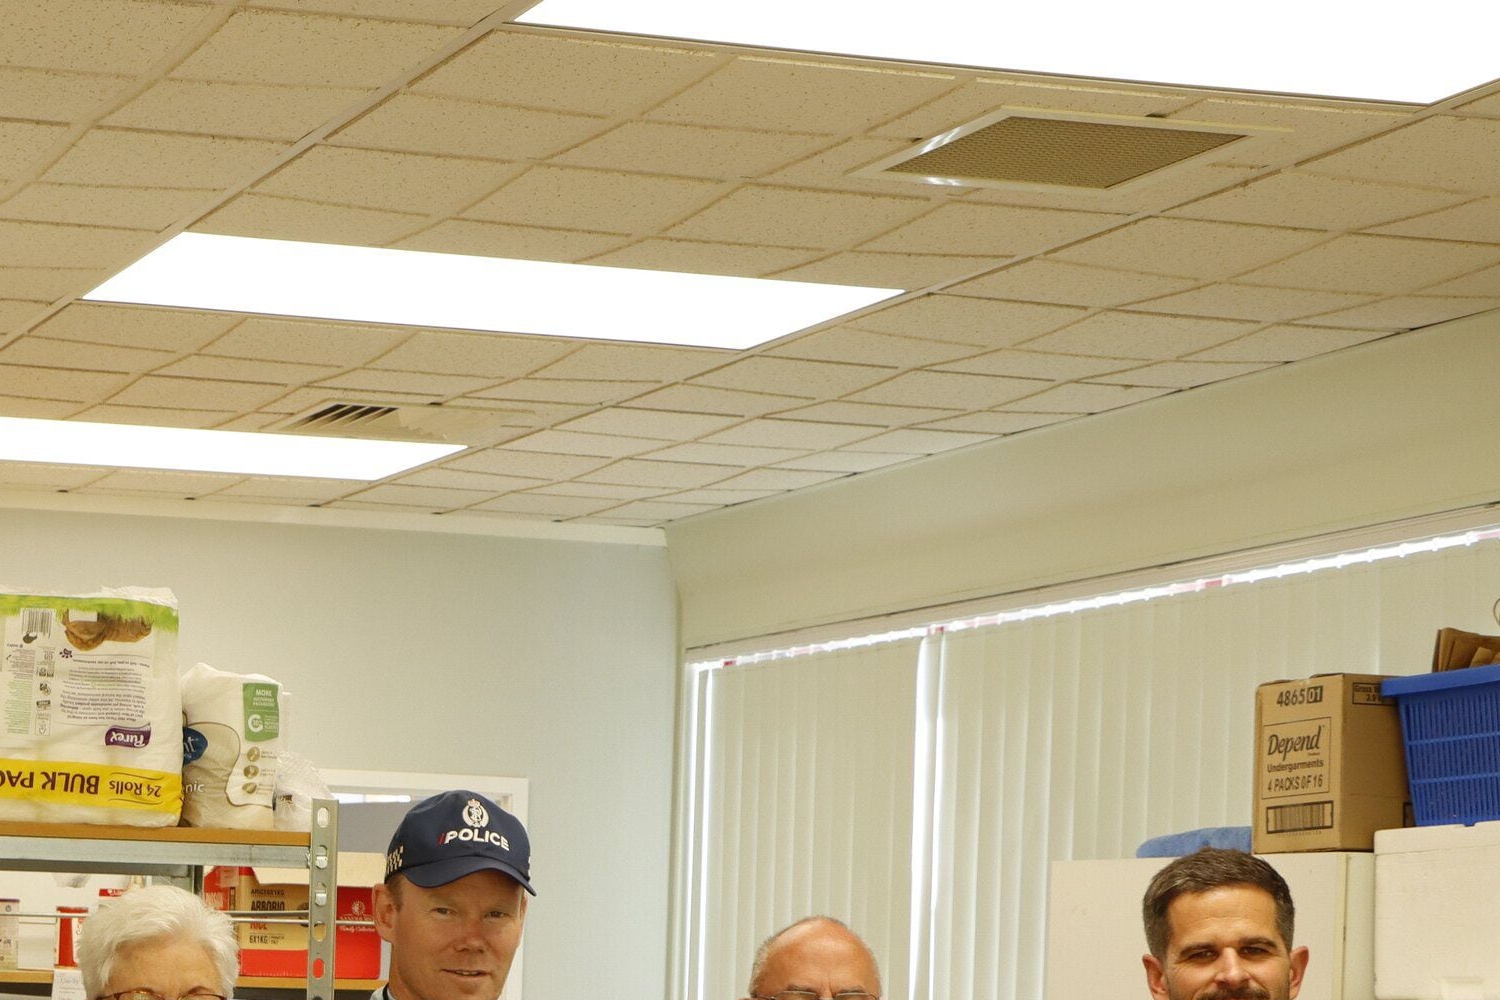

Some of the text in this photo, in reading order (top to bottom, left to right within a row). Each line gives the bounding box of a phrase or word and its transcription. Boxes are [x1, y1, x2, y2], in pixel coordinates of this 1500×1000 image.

[109, 731, 145, 747] Purex
[1268, 725, 1322, 761] Depend
[1267, 759, 1324, 773] Undergarments
[41, 771, 100, 796] BULK
[108, 779, 142, 795] Rolls
[146, 782, 162, 798] 24
[1267, 774, 1323, 792] 4 PACKS OF 16
[444, 828, 509, 851] POLICE
